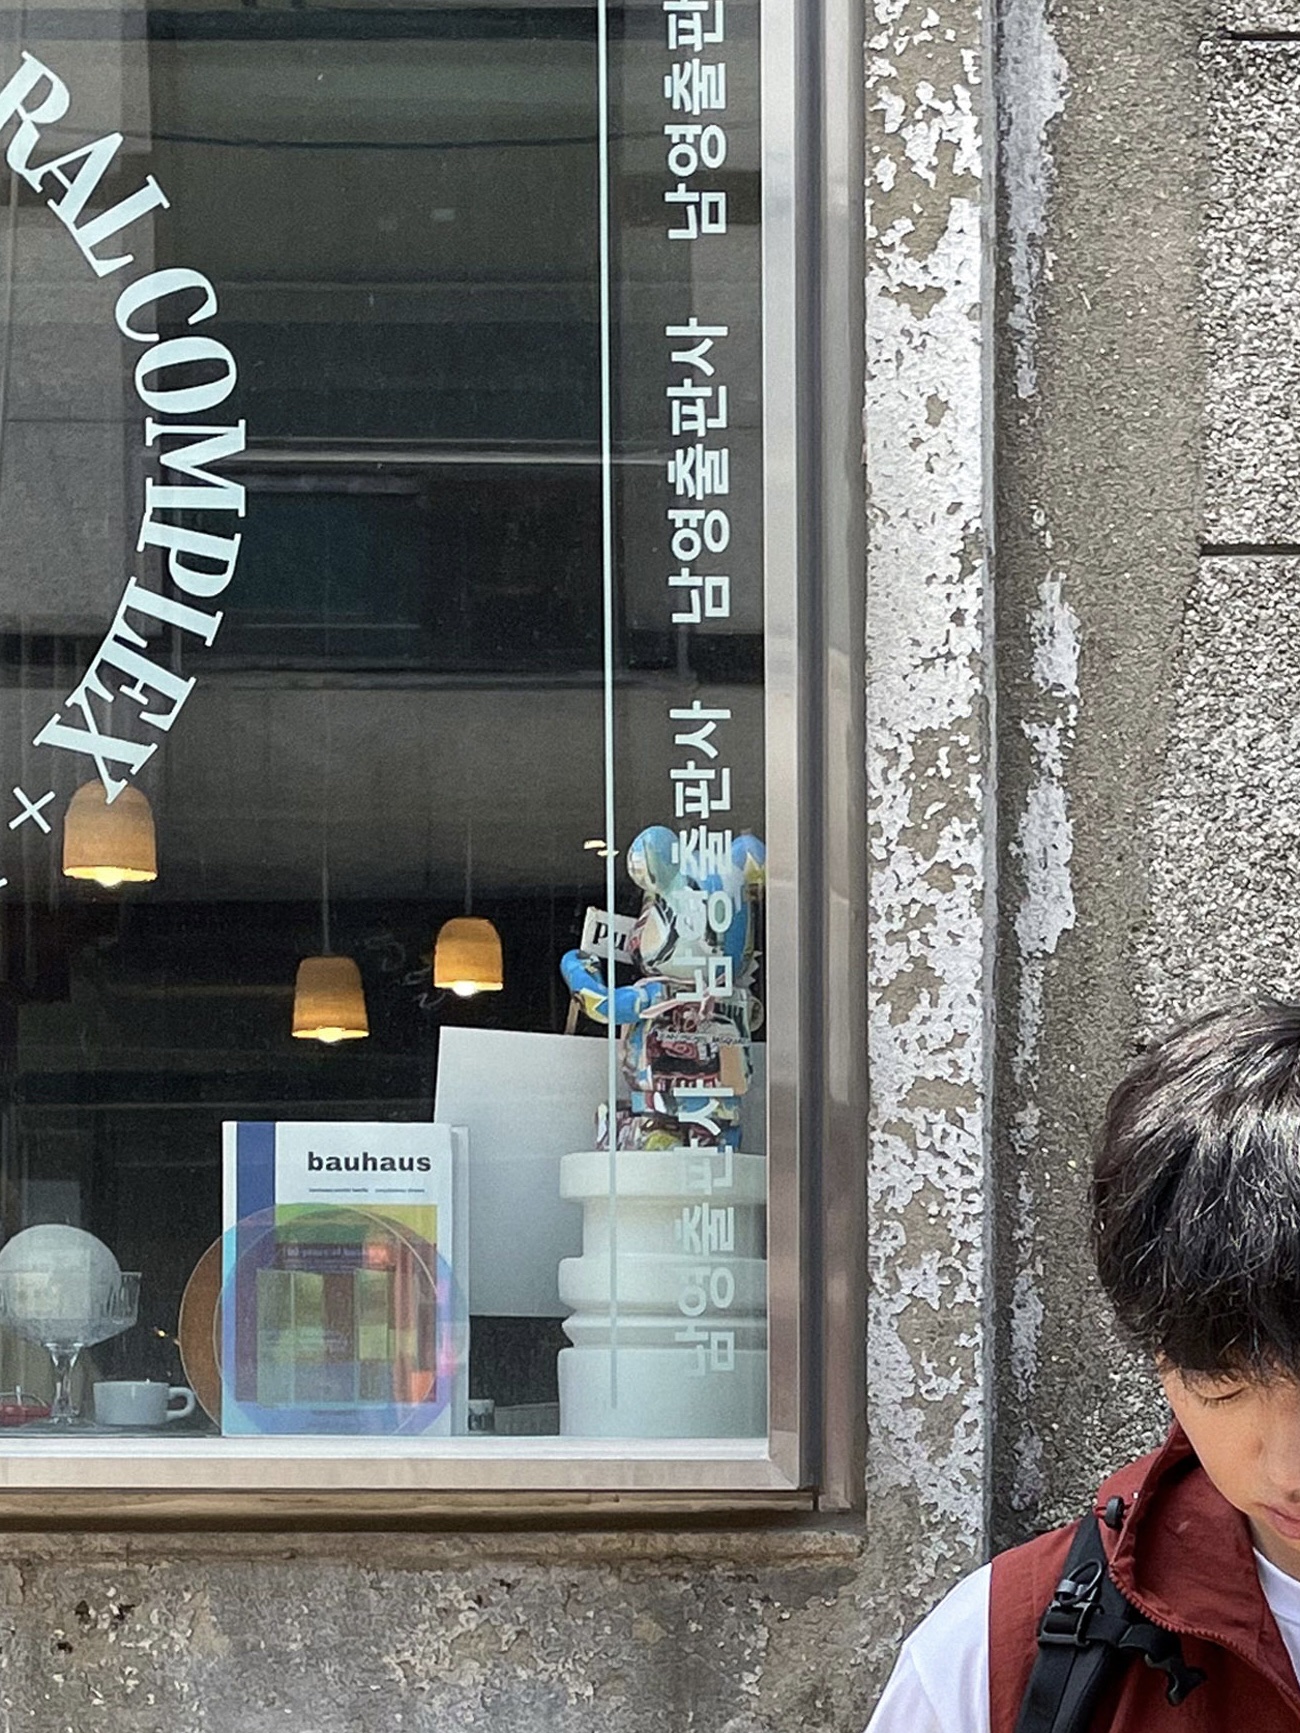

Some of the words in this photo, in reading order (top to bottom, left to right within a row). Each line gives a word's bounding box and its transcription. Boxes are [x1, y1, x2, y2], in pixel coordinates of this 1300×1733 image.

[33, 267, 246, 805] COMPLEX
[665, 317, 731, 624] 남영출판사
[668, 700, 733, 1004] 남영출판사
[307, 1150, 432, 1173] bauhaus
[672, 1079, 736, 1377] 남영출판사
